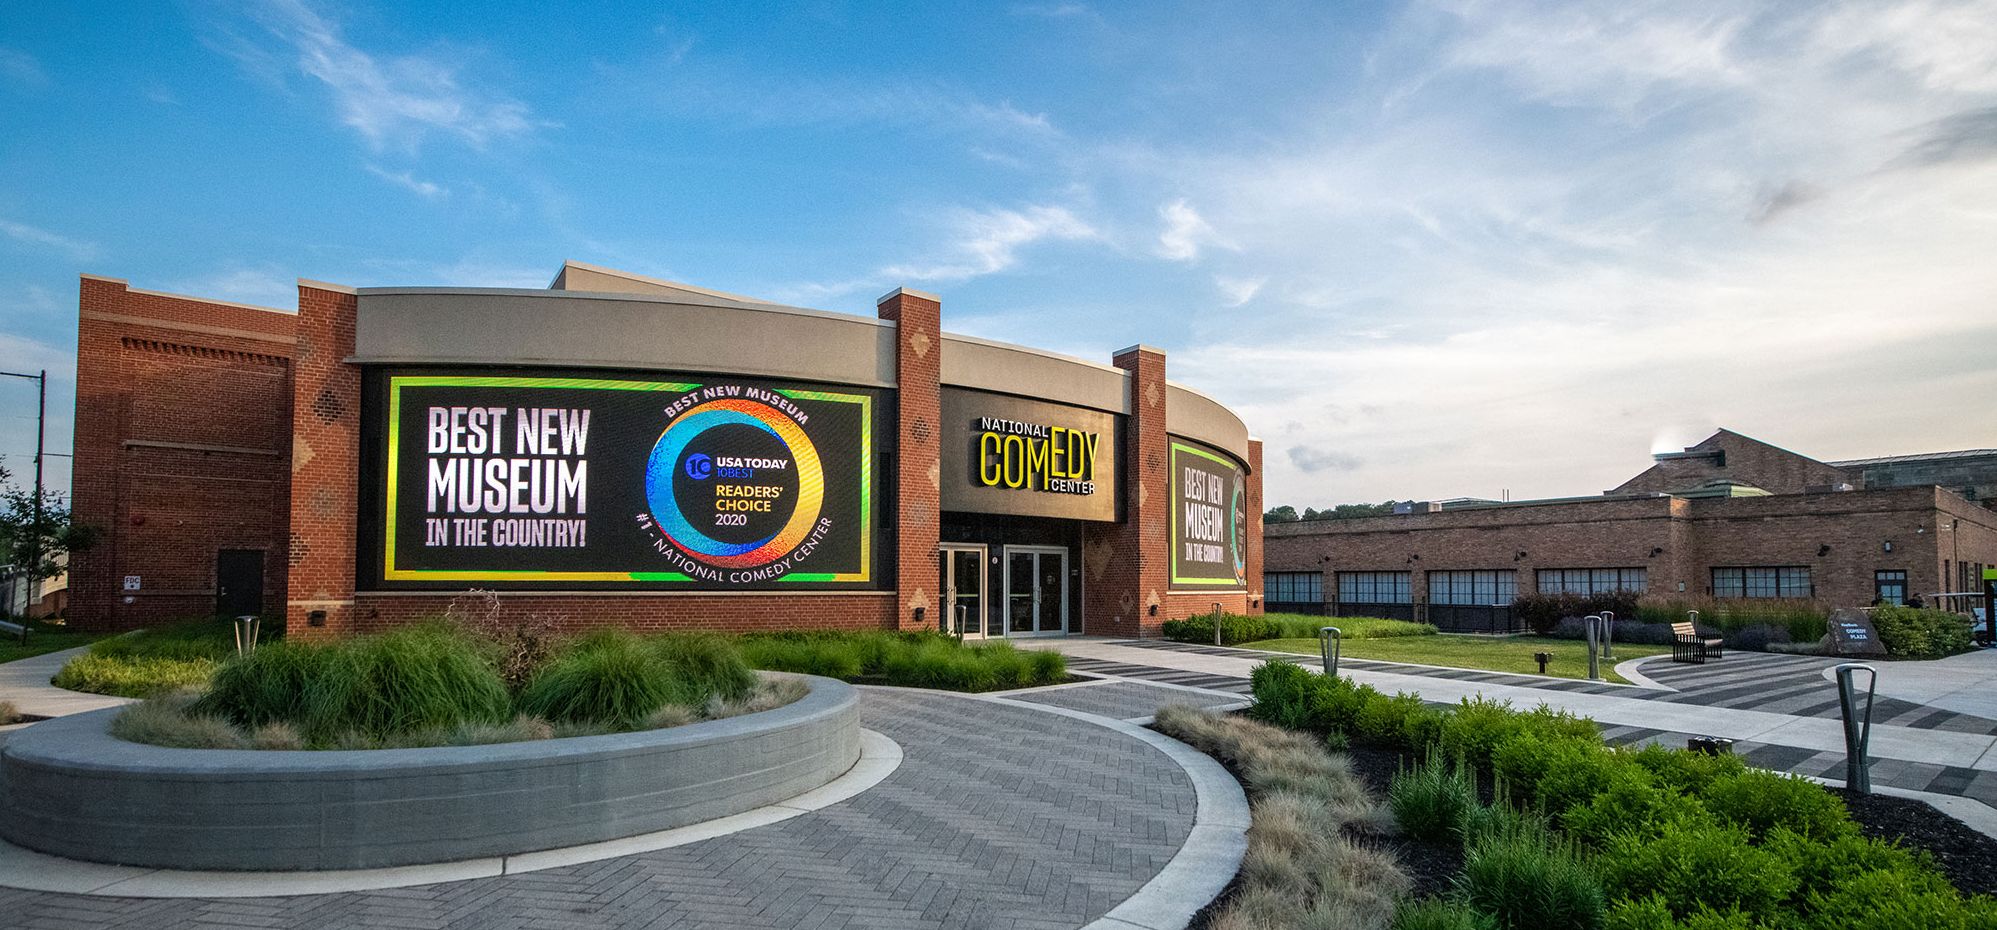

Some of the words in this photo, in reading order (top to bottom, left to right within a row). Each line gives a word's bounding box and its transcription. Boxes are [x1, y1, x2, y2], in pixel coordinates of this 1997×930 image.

[664, 391, 700, 419] BEST
[703, 385, 741, 399] NEW
[745, 386, 809, 425] MUSEUM
[427, 406, 508, 454] BEST
[516, 407, 591, 456] NEW
[981, 416, 1049, 438] NATIONAL
[716, 456, 743, 468] USA
[744, 458, 788, 469] TODAY
[980, 425, 1101, 490] COMEDY
[427, 457, 588, 514] MUSEUM
[716, 467, 755, 479] 10BEST
[1051, 478, 1096, 495] CENTER
[1184, 466, 1207, 502] BEST
[1208, 473, 1224, 506] NEW
[715, 499, 772, 512] CHOICE
[715, 513, 747, 526] 2020
[425, 518, 448, 547] IN
[453, 518, 488, 547] THE
[492, 518, 587, 548] COUNTRY!
[1185, 501, 1224, 543] MUSEUM
[636, 513, 653, 530] #1
[653, 538, 724, 582] NATIONAL
[730, 558, 792, 583] COMEDY
[793, 517, 833, 562] CENTER
[1185, 542, 1193, 561] IN
[1193, 543, 1203, 562] THE
